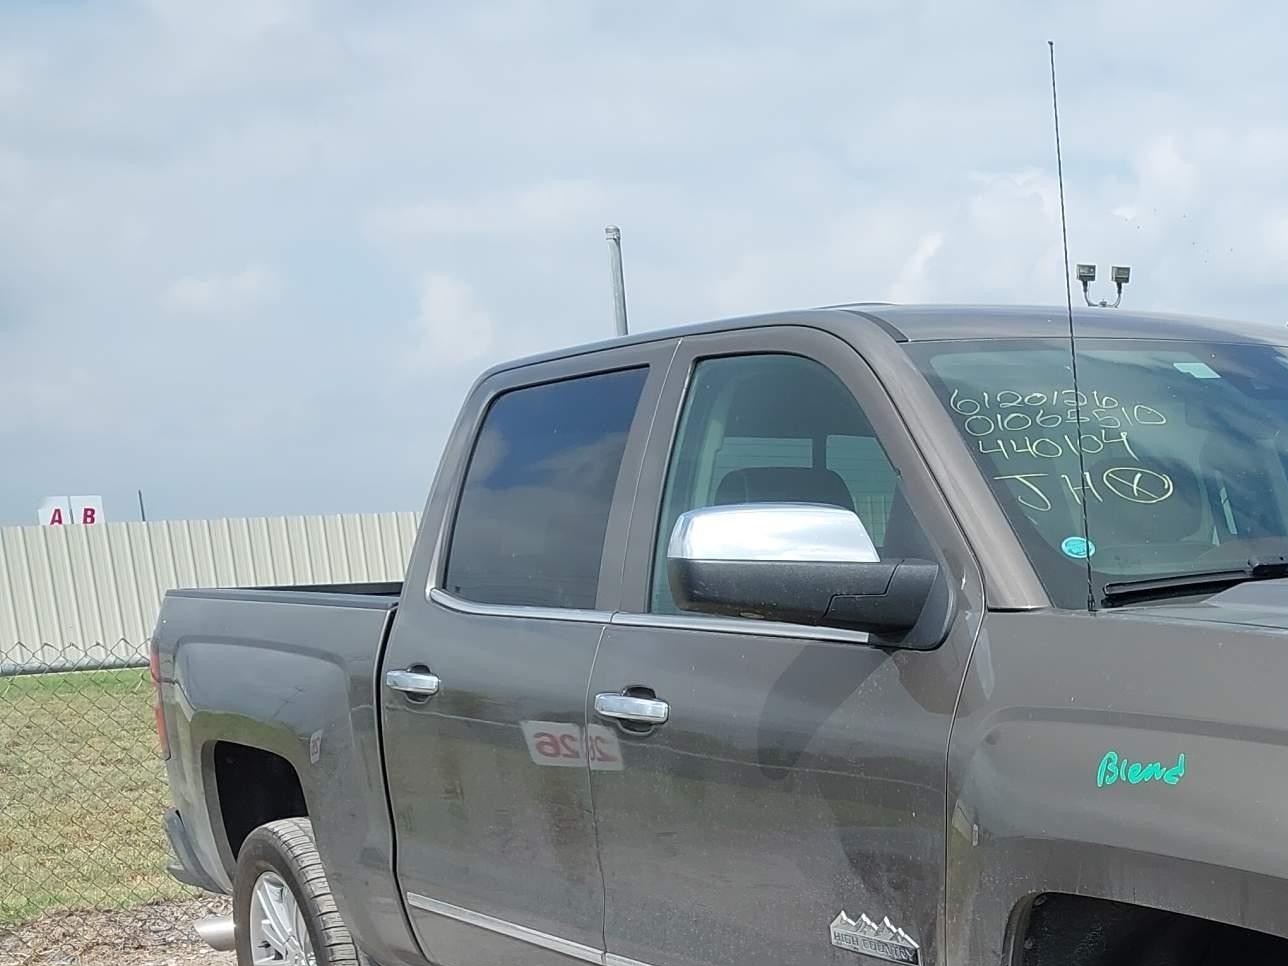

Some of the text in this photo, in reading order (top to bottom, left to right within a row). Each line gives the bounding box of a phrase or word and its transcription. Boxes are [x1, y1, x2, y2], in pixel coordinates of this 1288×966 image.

[978, 429, 1140, 461] 440104
[51, 508, 95, 524] A B
[1096, 750, 1186, 788] Blend
[833, 930, 915, 961] HIGH COUNTRY
